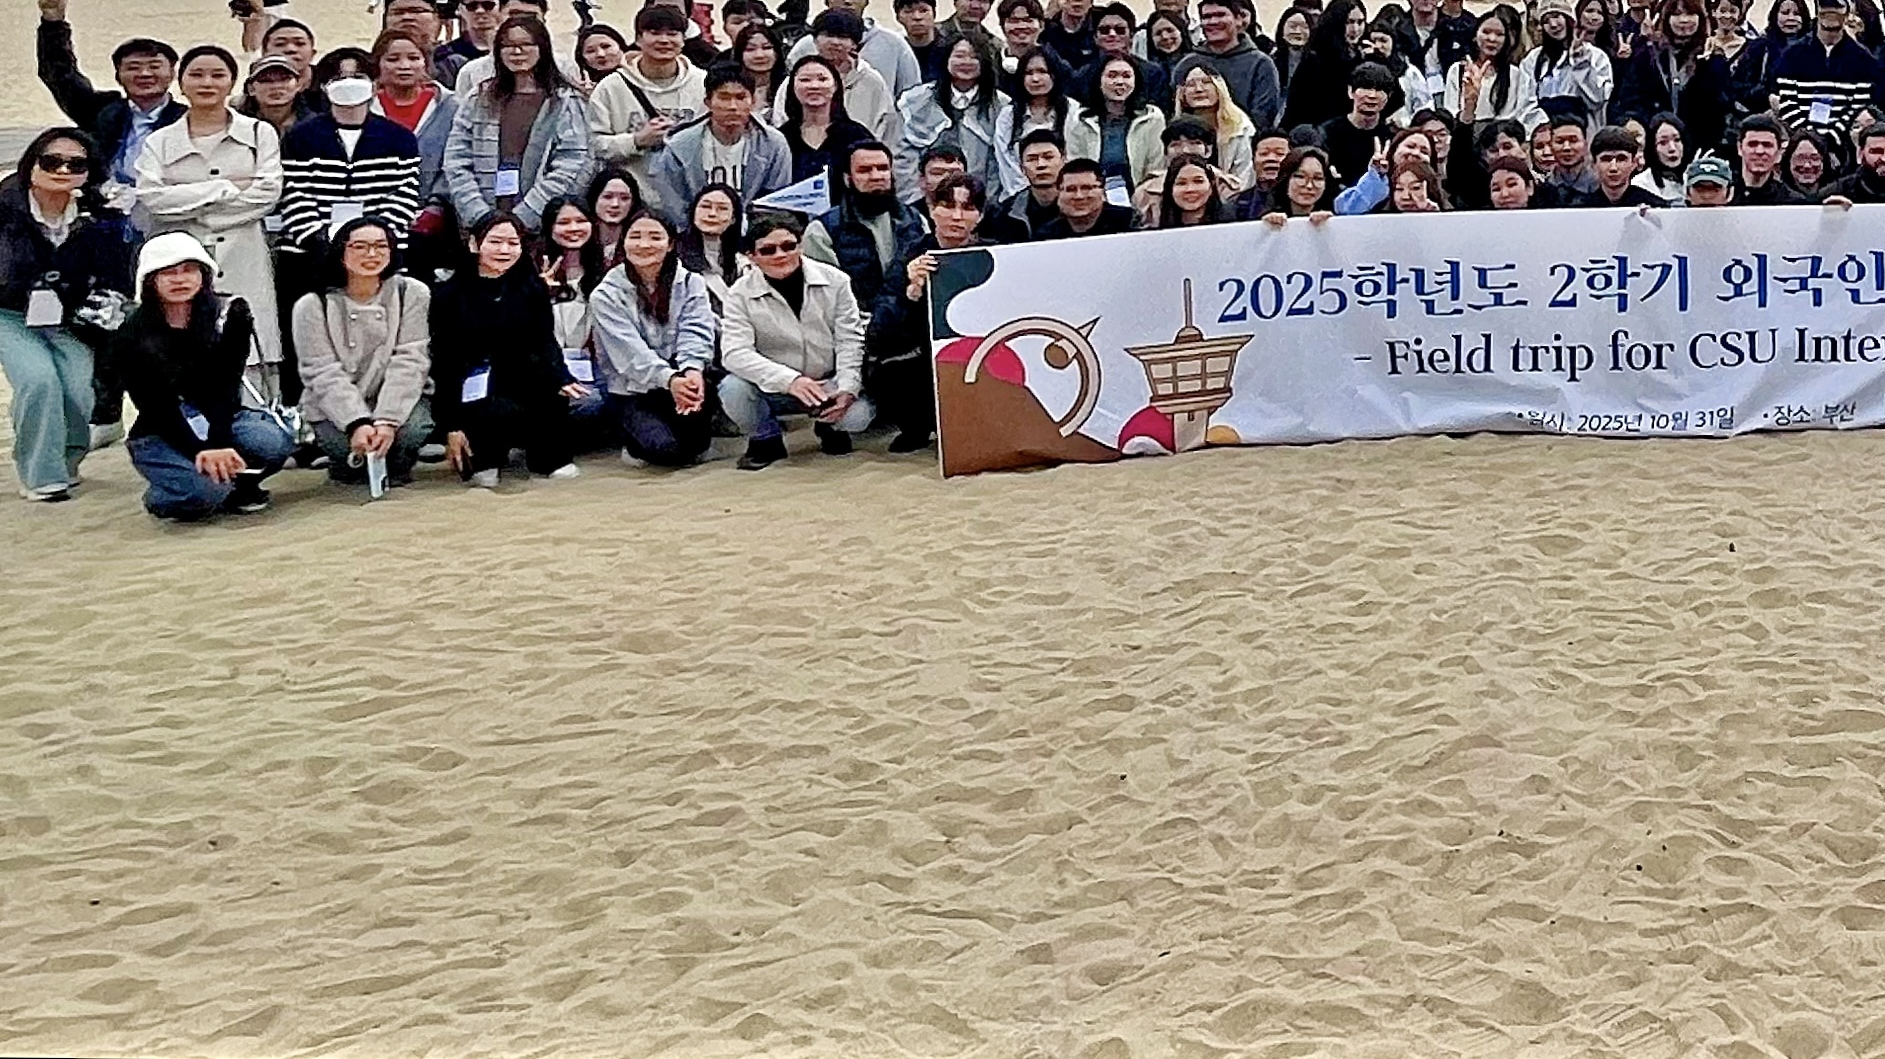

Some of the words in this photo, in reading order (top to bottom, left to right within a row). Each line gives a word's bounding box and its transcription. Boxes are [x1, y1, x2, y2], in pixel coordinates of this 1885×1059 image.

[1217, 259, 1528, 323] 2025학년도
[1548, 254, 1689, 313] 2학기
[1385, 333, 1495, 376] Field
[1510, 333, 1594, 383] trip
[1608, 329, 1675, 372] for
[1689, 327, 1779, 369] CSU
[1577, 413, 1643, 432] 2025년
[1650, 411, 1688, 431] 10월
[1695, 406, 1734, 430] 31일
[1822, 401, 1856, 425] 부산
